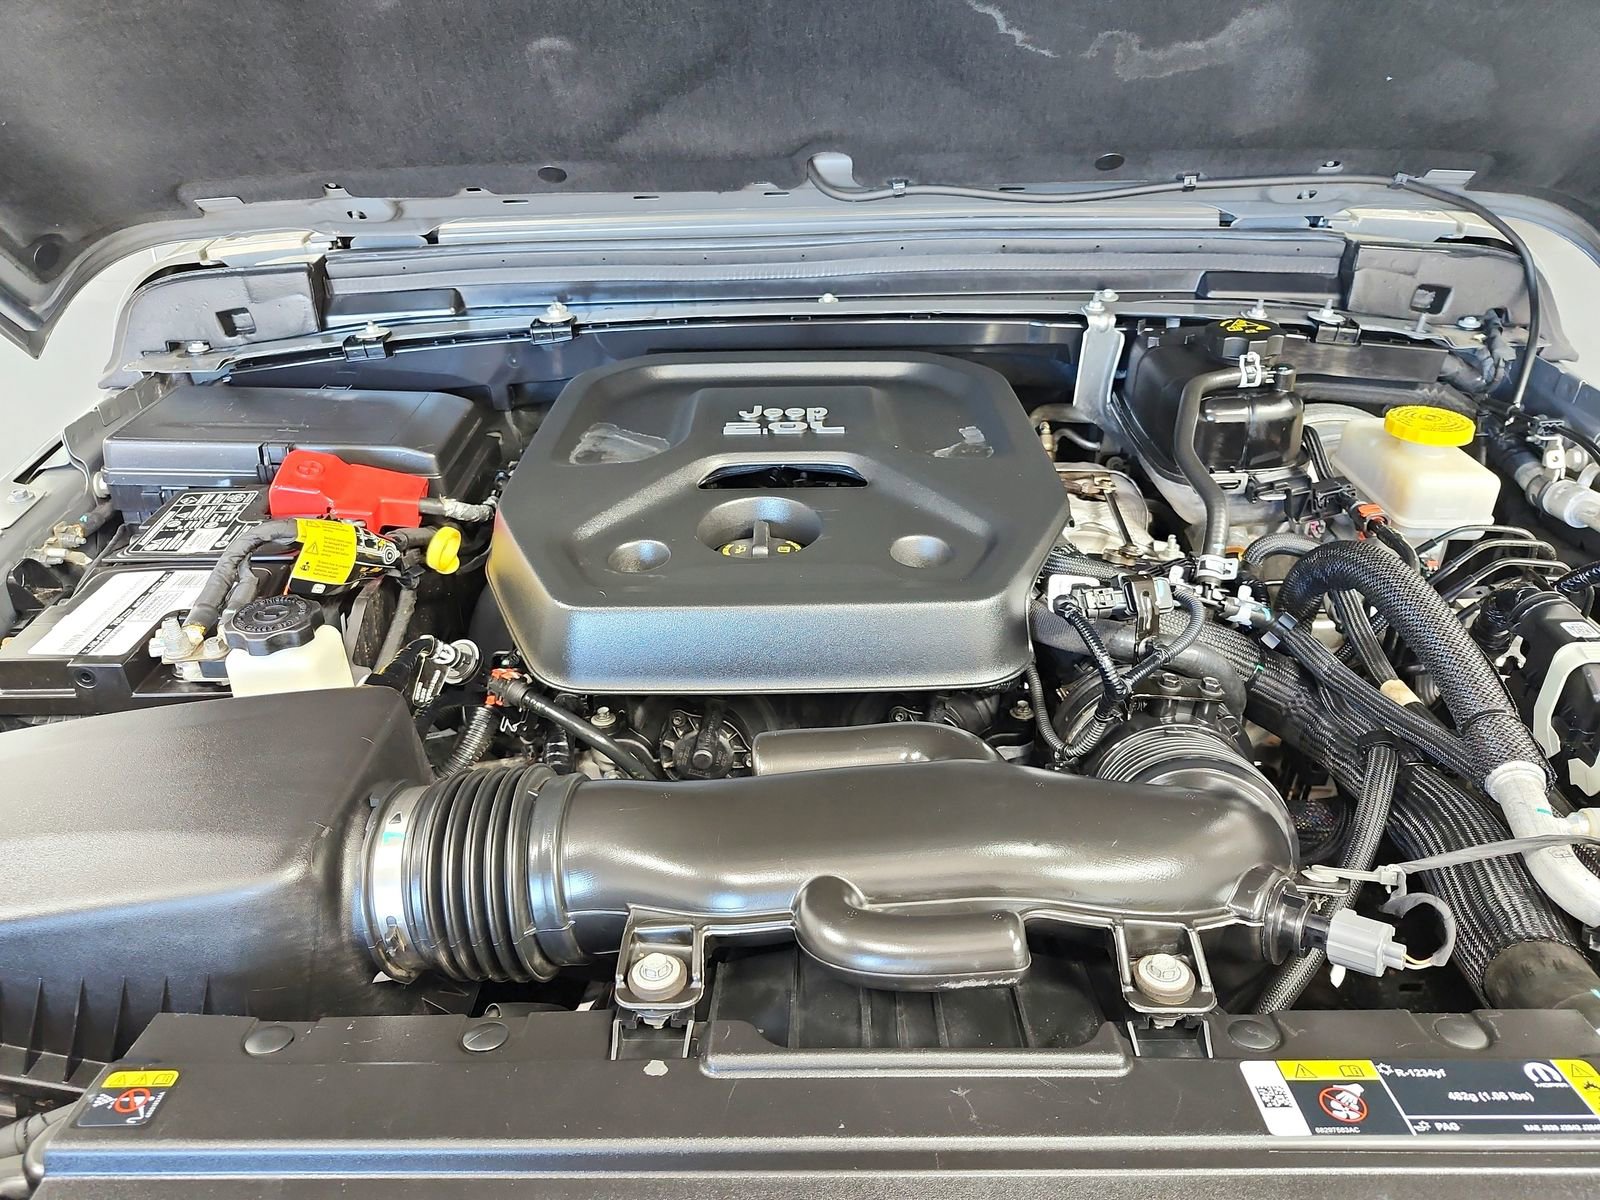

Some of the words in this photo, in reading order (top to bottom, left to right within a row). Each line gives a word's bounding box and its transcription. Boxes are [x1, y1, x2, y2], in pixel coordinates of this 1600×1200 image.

[738, 405, 828, 421] Jeep
[723, 421, 845, 435] 2.0L
[1394, 1068, 1447, 1079] R-1234yf
[1434, 1122, 1461, 1131] PAG
